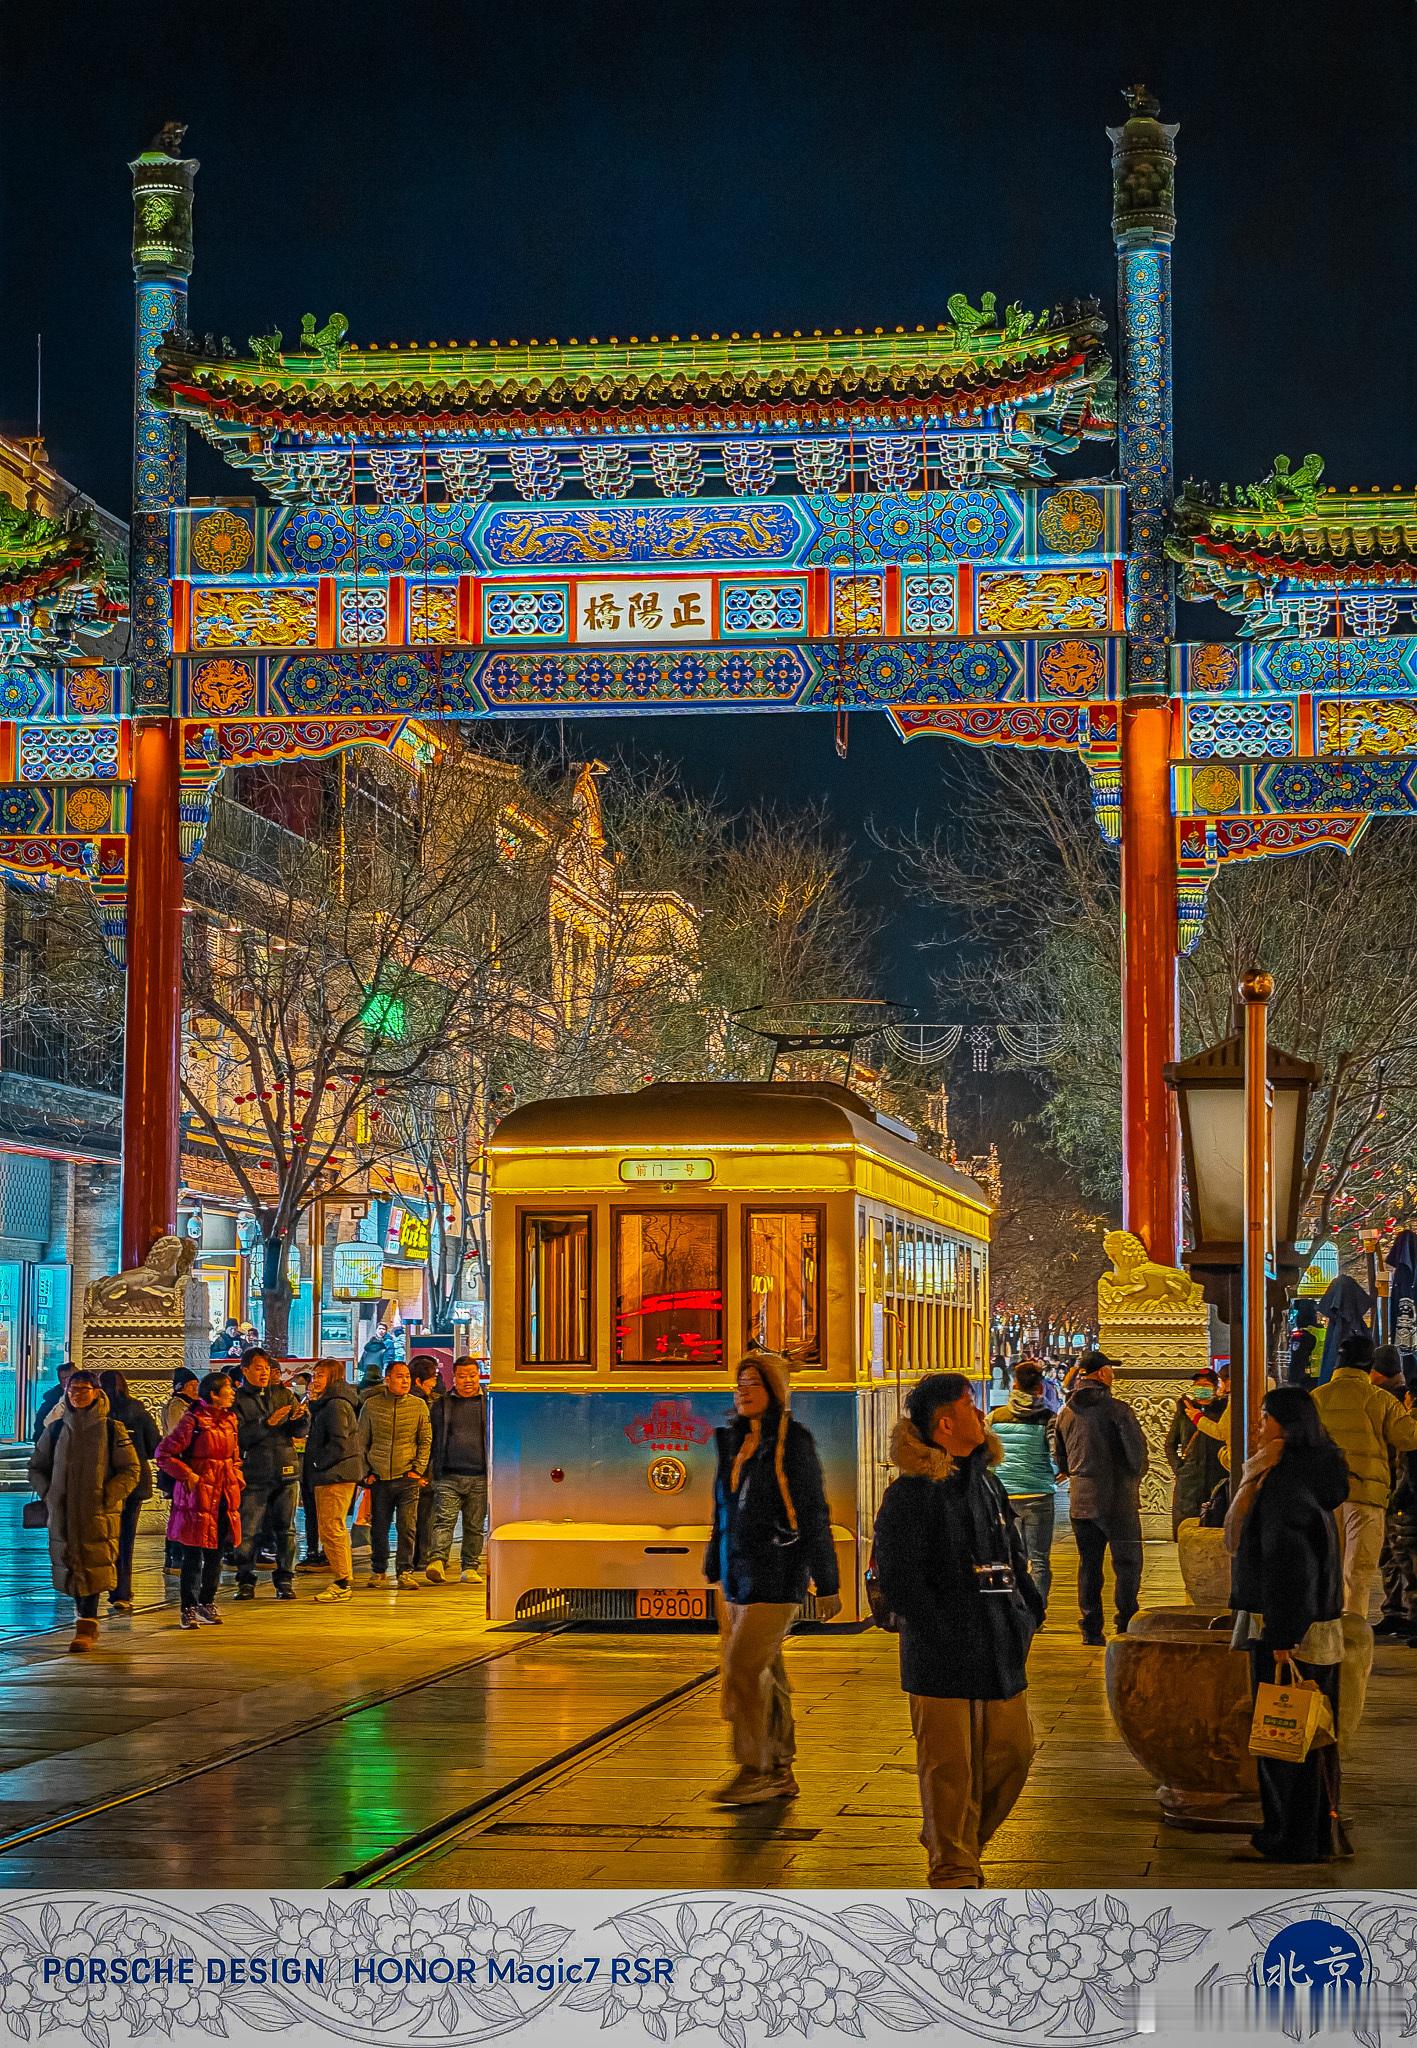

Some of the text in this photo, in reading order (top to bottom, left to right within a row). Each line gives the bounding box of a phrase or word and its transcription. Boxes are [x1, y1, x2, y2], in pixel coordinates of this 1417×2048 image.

[635, 1163, 695, 1177] 前门一号
[640, 1597, 703, 1617] D9800
